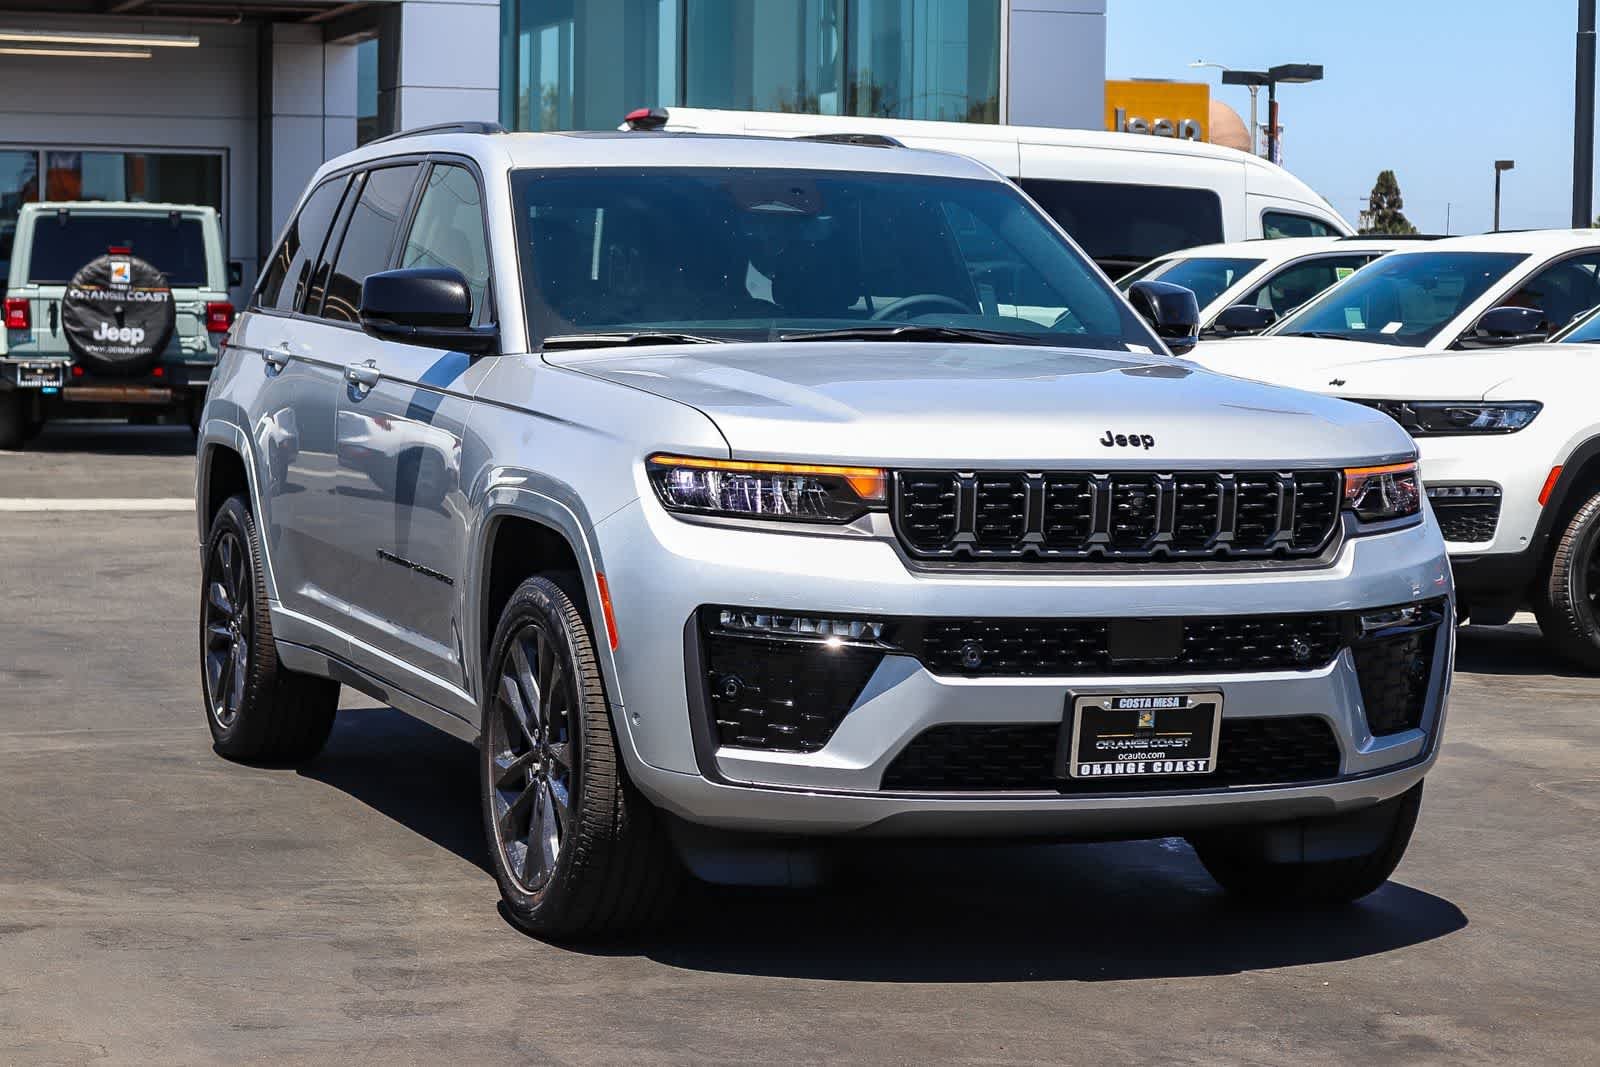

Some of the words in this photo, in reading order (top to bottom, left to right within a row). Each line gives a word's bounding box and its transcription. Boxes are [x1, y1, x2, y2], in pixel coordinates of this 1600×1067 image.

[70, 289, 125, 300] ORANGE
[127, 292, 169, 302] COAST
[93, 322, 145, 345] Jeep
[1099, 430, 1155, 450] Jeep
[1119, 698, 1151, 708] COSTA
[1152, 697, 1179, 707] MESA
[1096, 739, 1148, 749] ORANGE
[1150, 738, 1190, 747] COAST
[1118, 751, 1165, 760] ocauto.com
[1081, 763, 1145, 775] ORANGE
[1153, 760, 1206, 772] COAST
